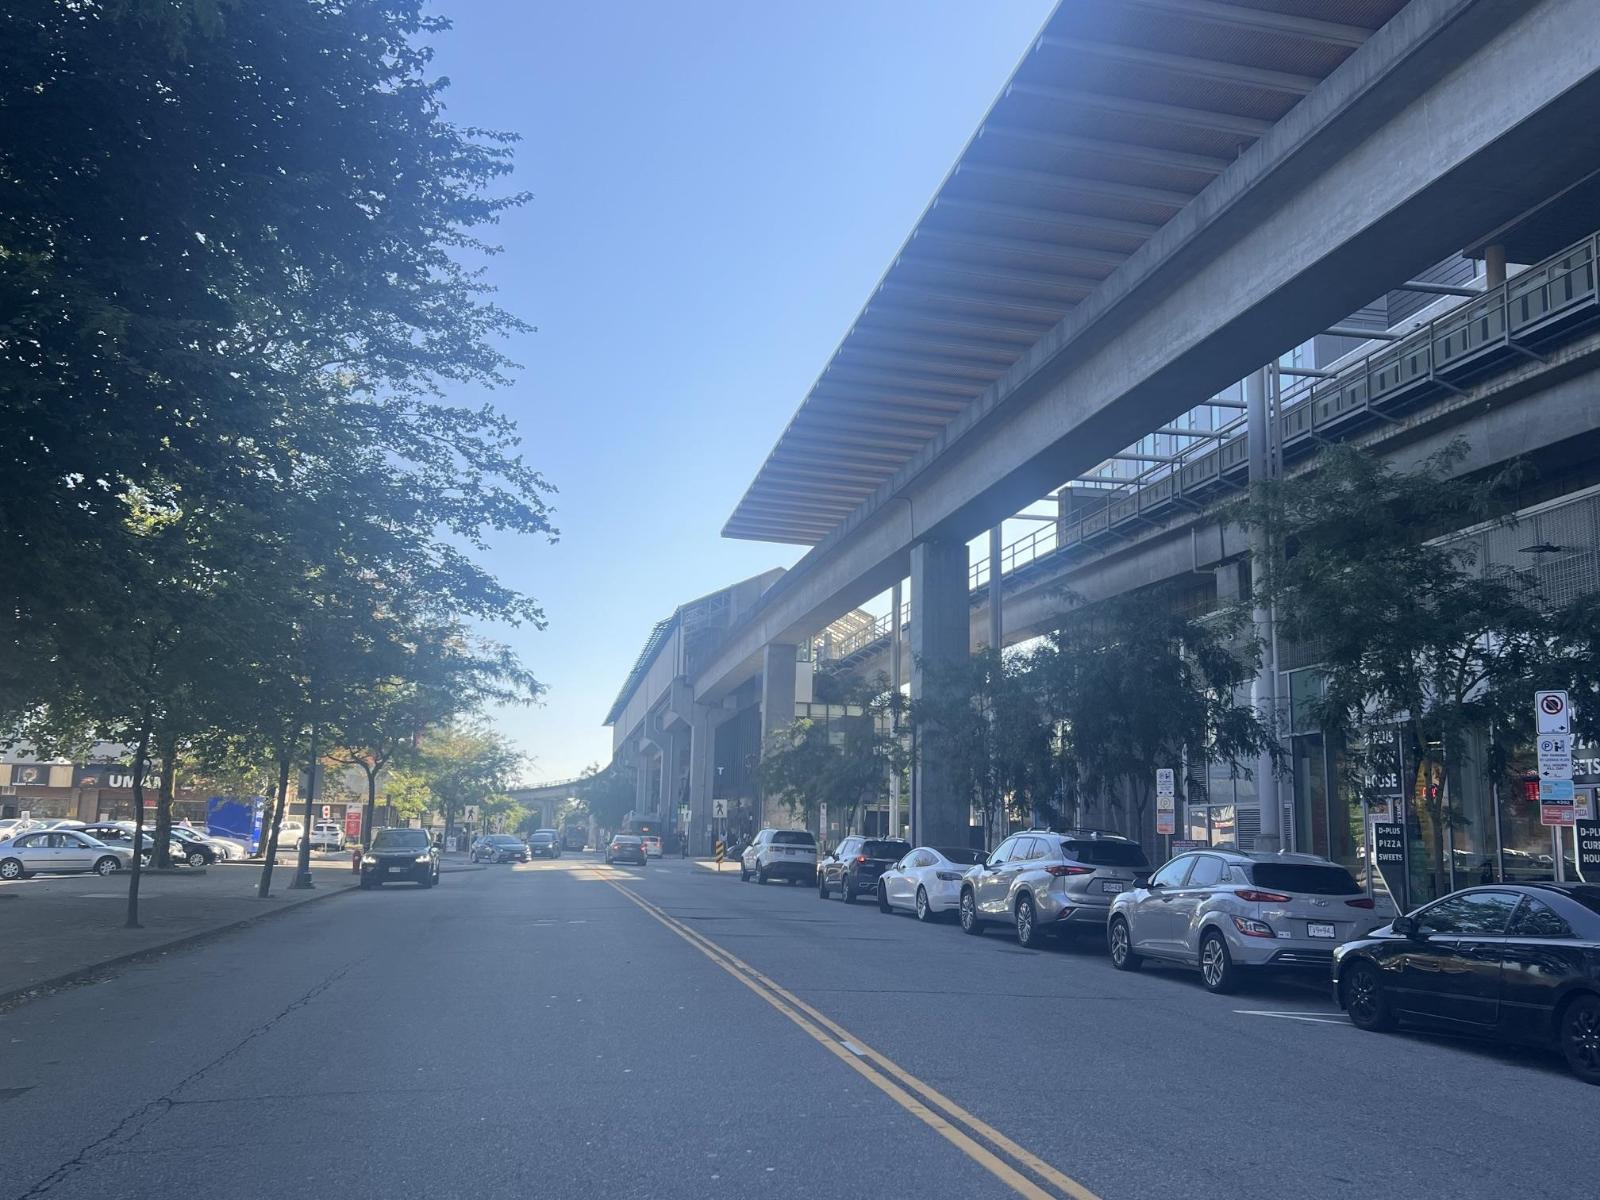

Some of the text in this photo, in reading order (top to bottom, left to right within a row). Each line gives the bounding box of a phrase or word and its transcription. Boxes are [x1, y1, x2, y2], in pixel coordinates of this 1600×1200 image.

[1378, 827, 1401, 835] D-PLUS
[1580, 827, 1600, 837] D-PL
[1378, 839, 1402, 848] PIZZA
[1378, 853, 1404, 861] SWEETS
[1583, 853, 1600, 863] HOU
